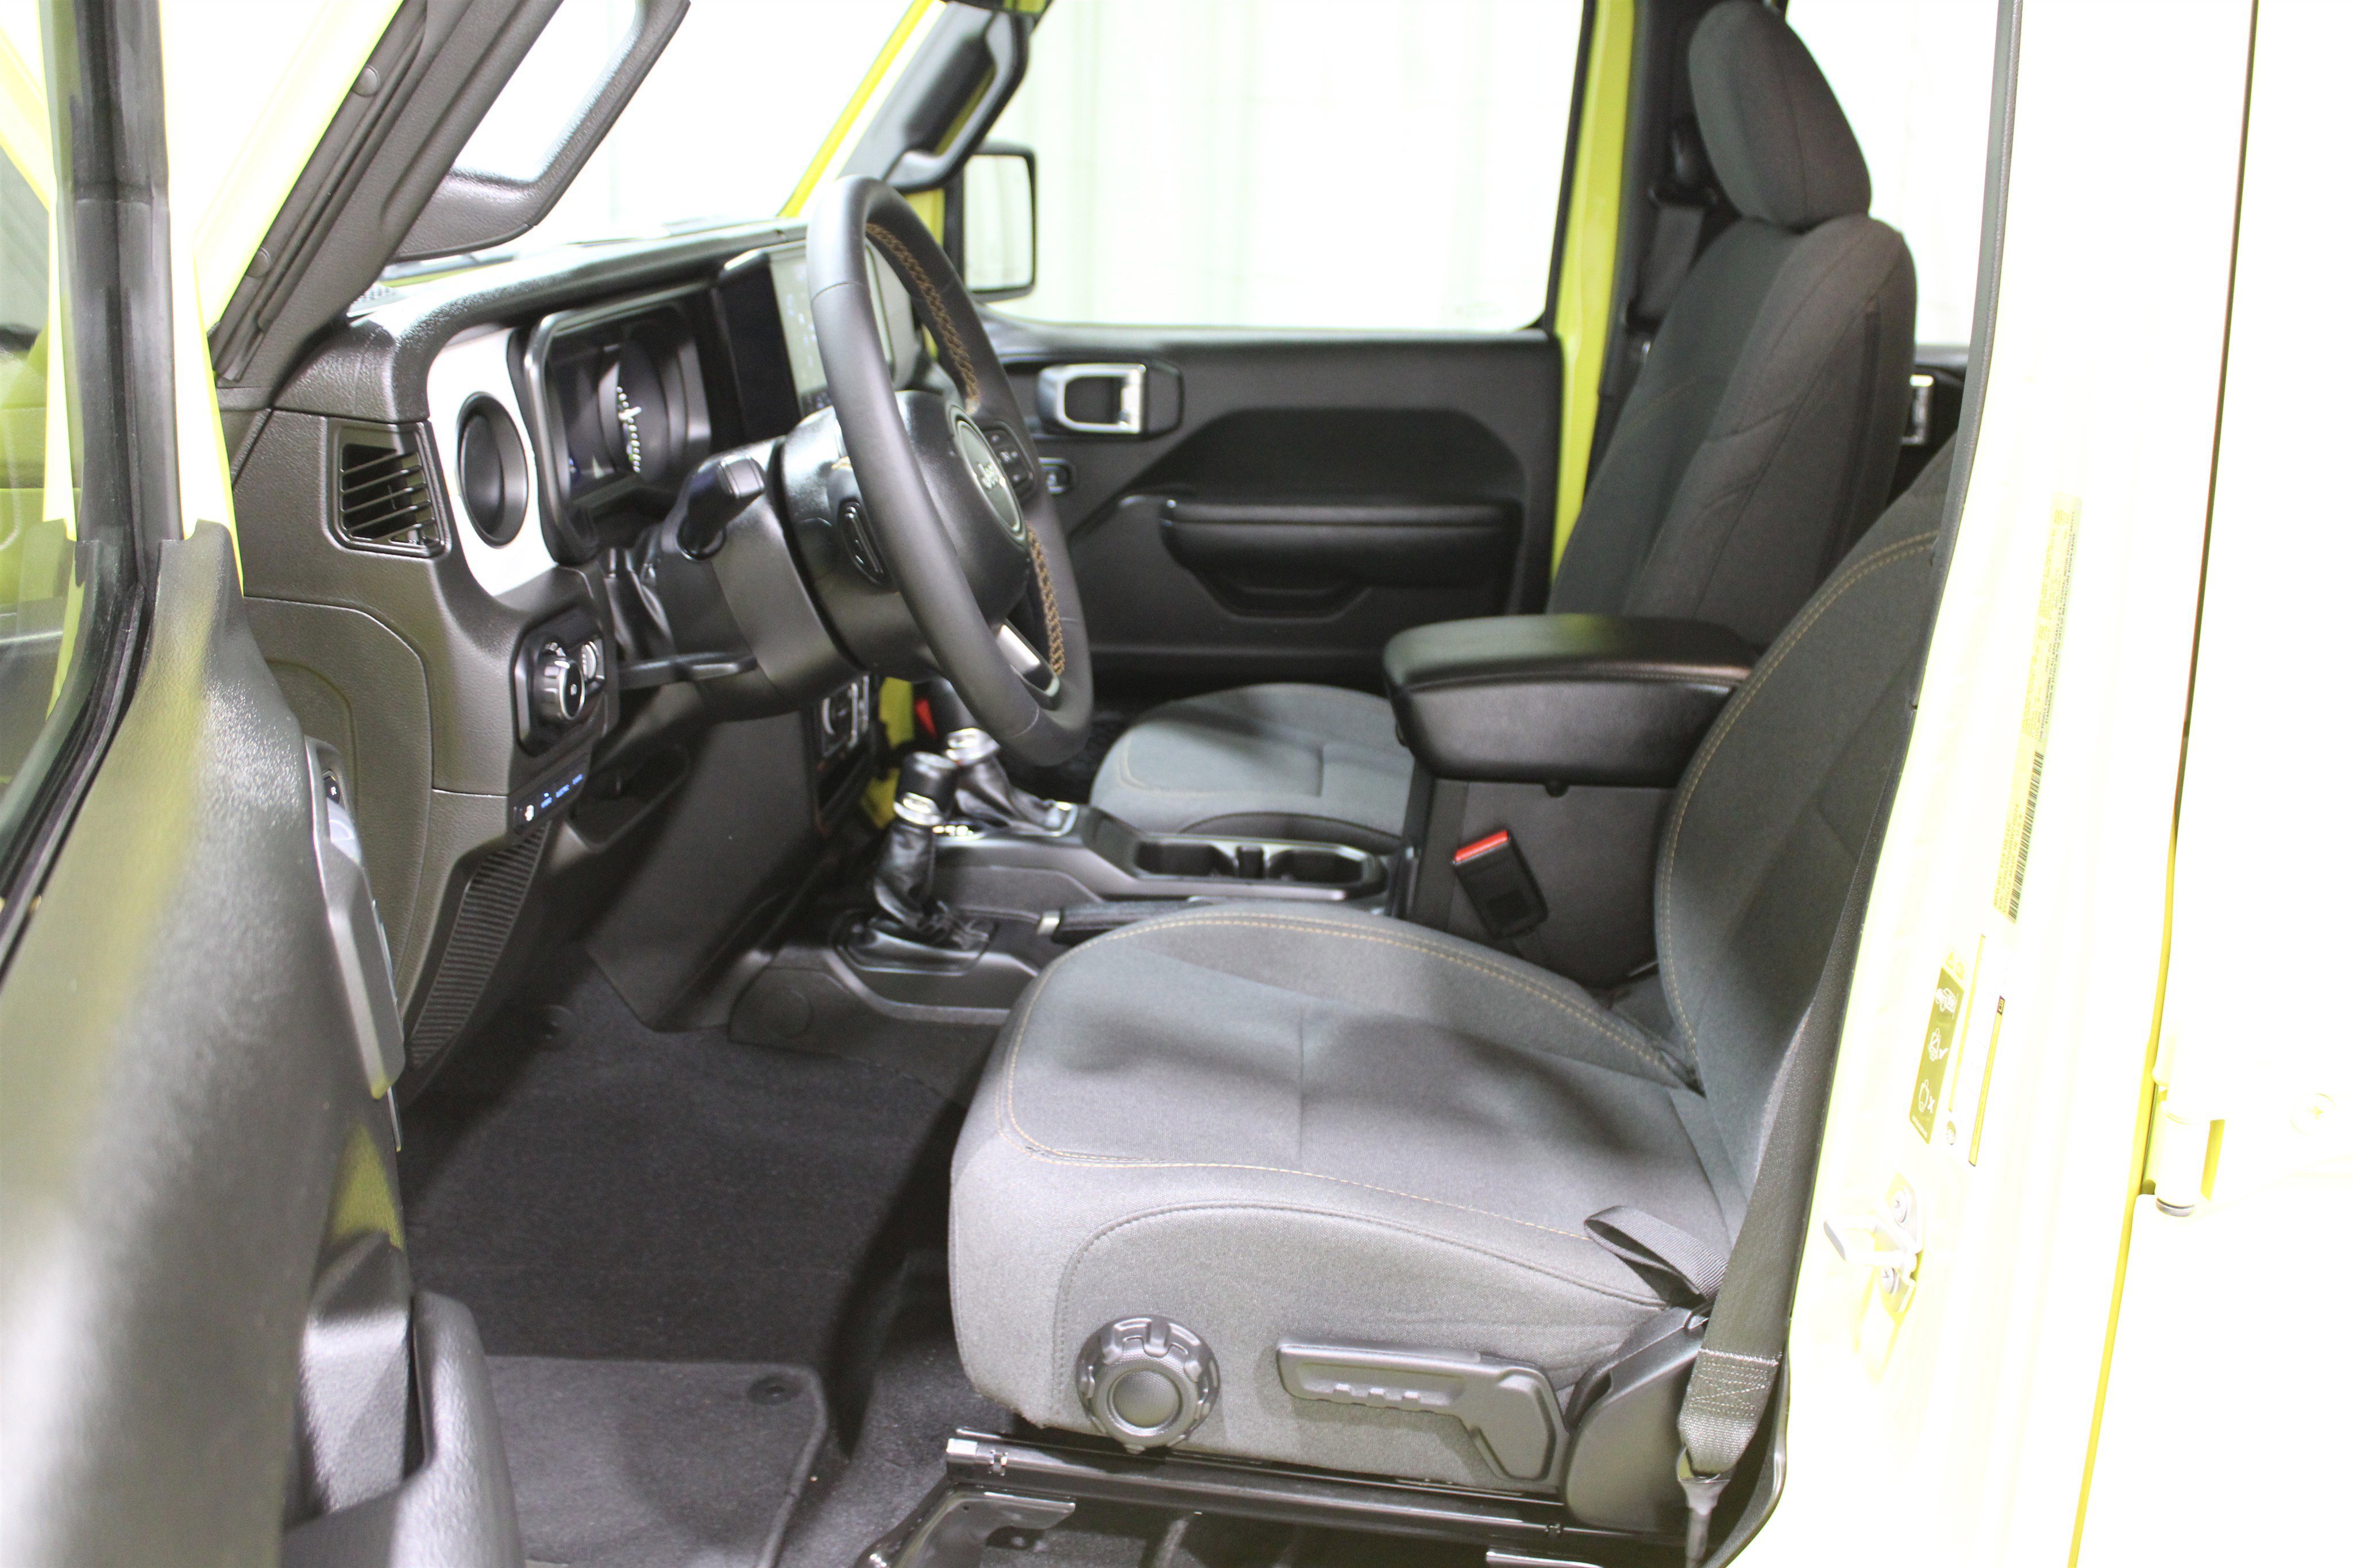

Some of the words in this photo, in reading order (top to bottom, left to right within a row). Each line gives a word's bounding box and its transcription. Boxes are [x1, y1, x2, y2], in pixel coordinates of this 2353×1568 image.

[2054, 654, 2058, 662] ON
[2061, 574, 2070, 616] MANUFACTURE
[331, 786, 337, 795] R
